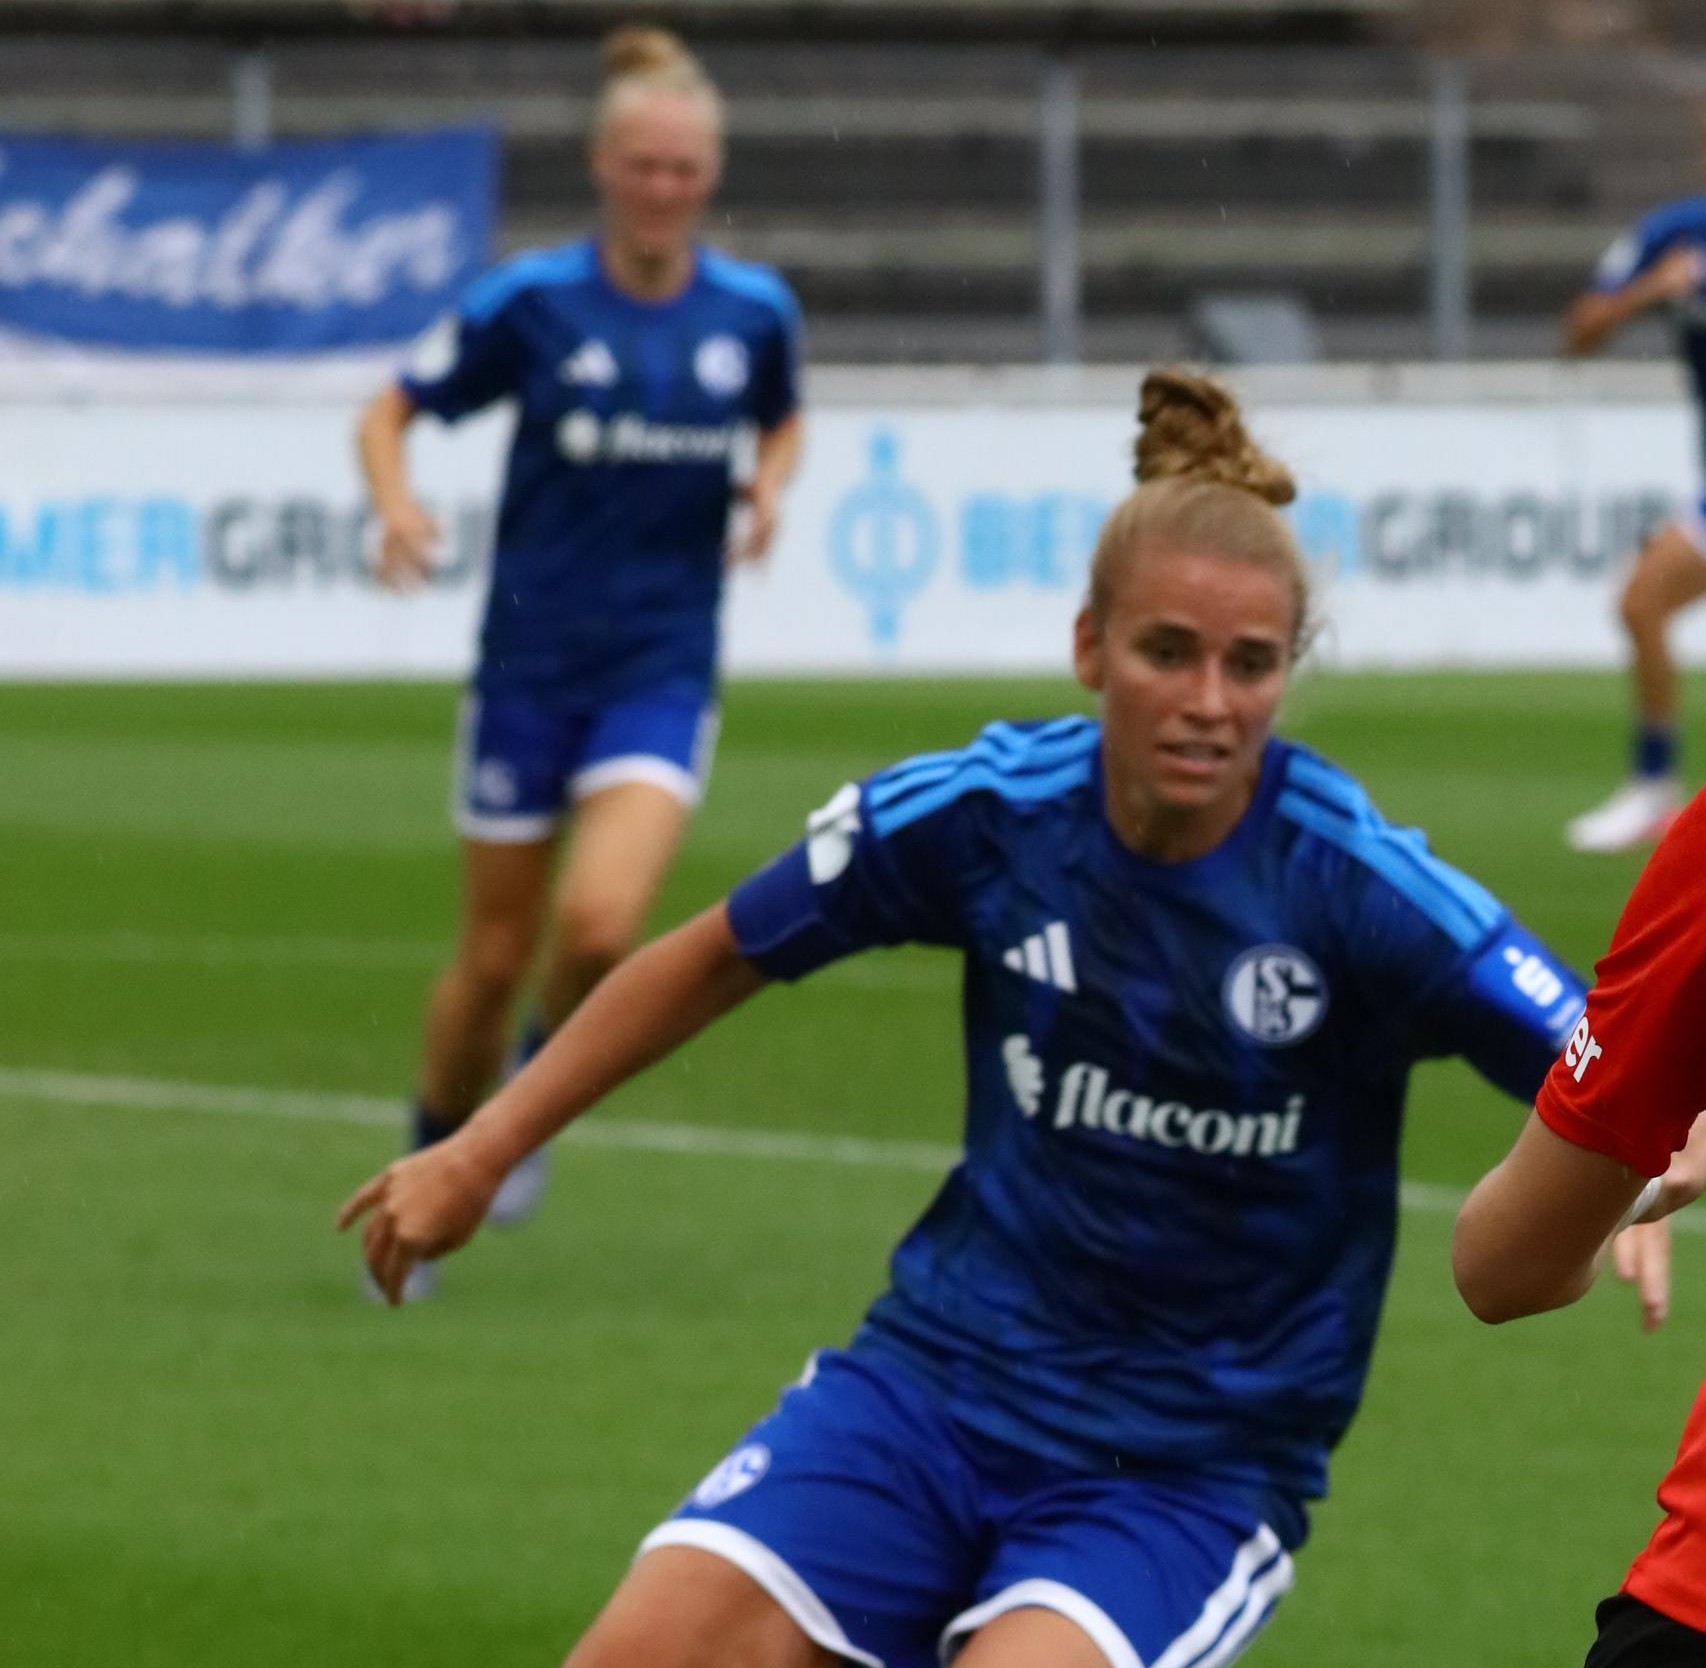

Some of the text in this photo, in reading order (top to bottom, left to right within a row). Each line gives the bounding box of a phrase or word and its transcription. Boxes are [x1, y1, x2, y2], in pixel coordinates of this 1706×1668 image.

[0, 167, 458, 306] chalker
[1565, 1016, 1603, 1083] er
[1052, 1062, 1305, 1157] flaconi
